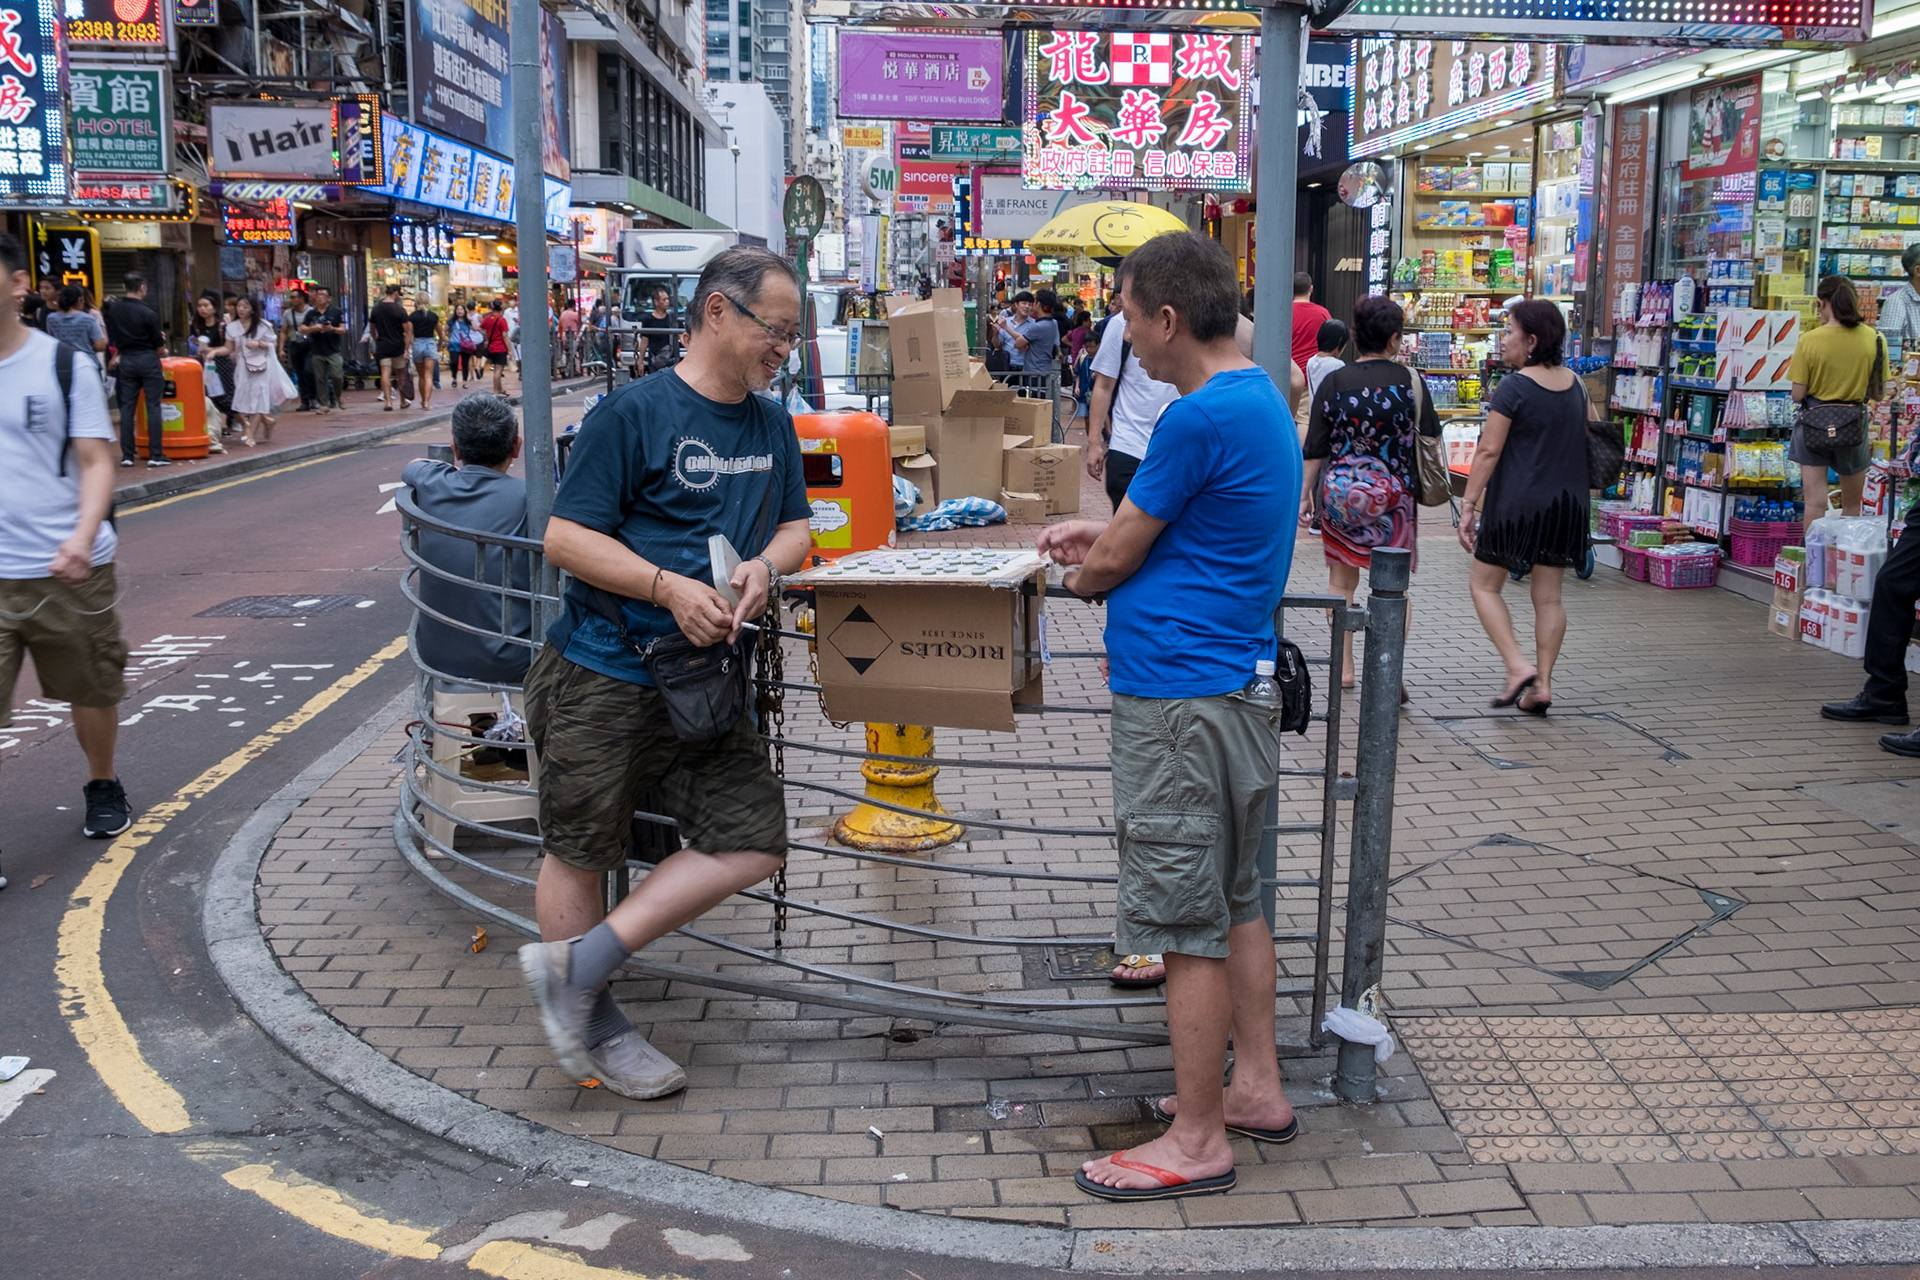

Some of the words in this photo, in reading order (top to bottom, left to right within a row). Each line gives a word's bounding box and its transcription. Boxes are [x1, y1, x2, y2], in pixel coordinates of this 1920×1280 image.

[920, 95, 938, 103] YUEN
[940, 96, 957, 104] KING
[958, 96, 991, 105] BUILDING
[78, 118, 158, 136] HOTEL
[1045, 89, 1233, 150] 大藥房
[1041, 150, 1134, 177] 政府註冊
[1143, 150, 1237, 178] 信心保證
[1617, 108, 1644, 216] 香港政府註冊
[870, 167, 894, 191] 5M
[79, 187, 152, 199] MASSAGE
[985, 198, 1006, 208] 法國
[1007, 199, 1048, 209] FRANCE
[921, 629, 945, 638] 1838
[951, 630, 985, 639] SINCE
[901, 641, 1005, 660] RICQLÈS
